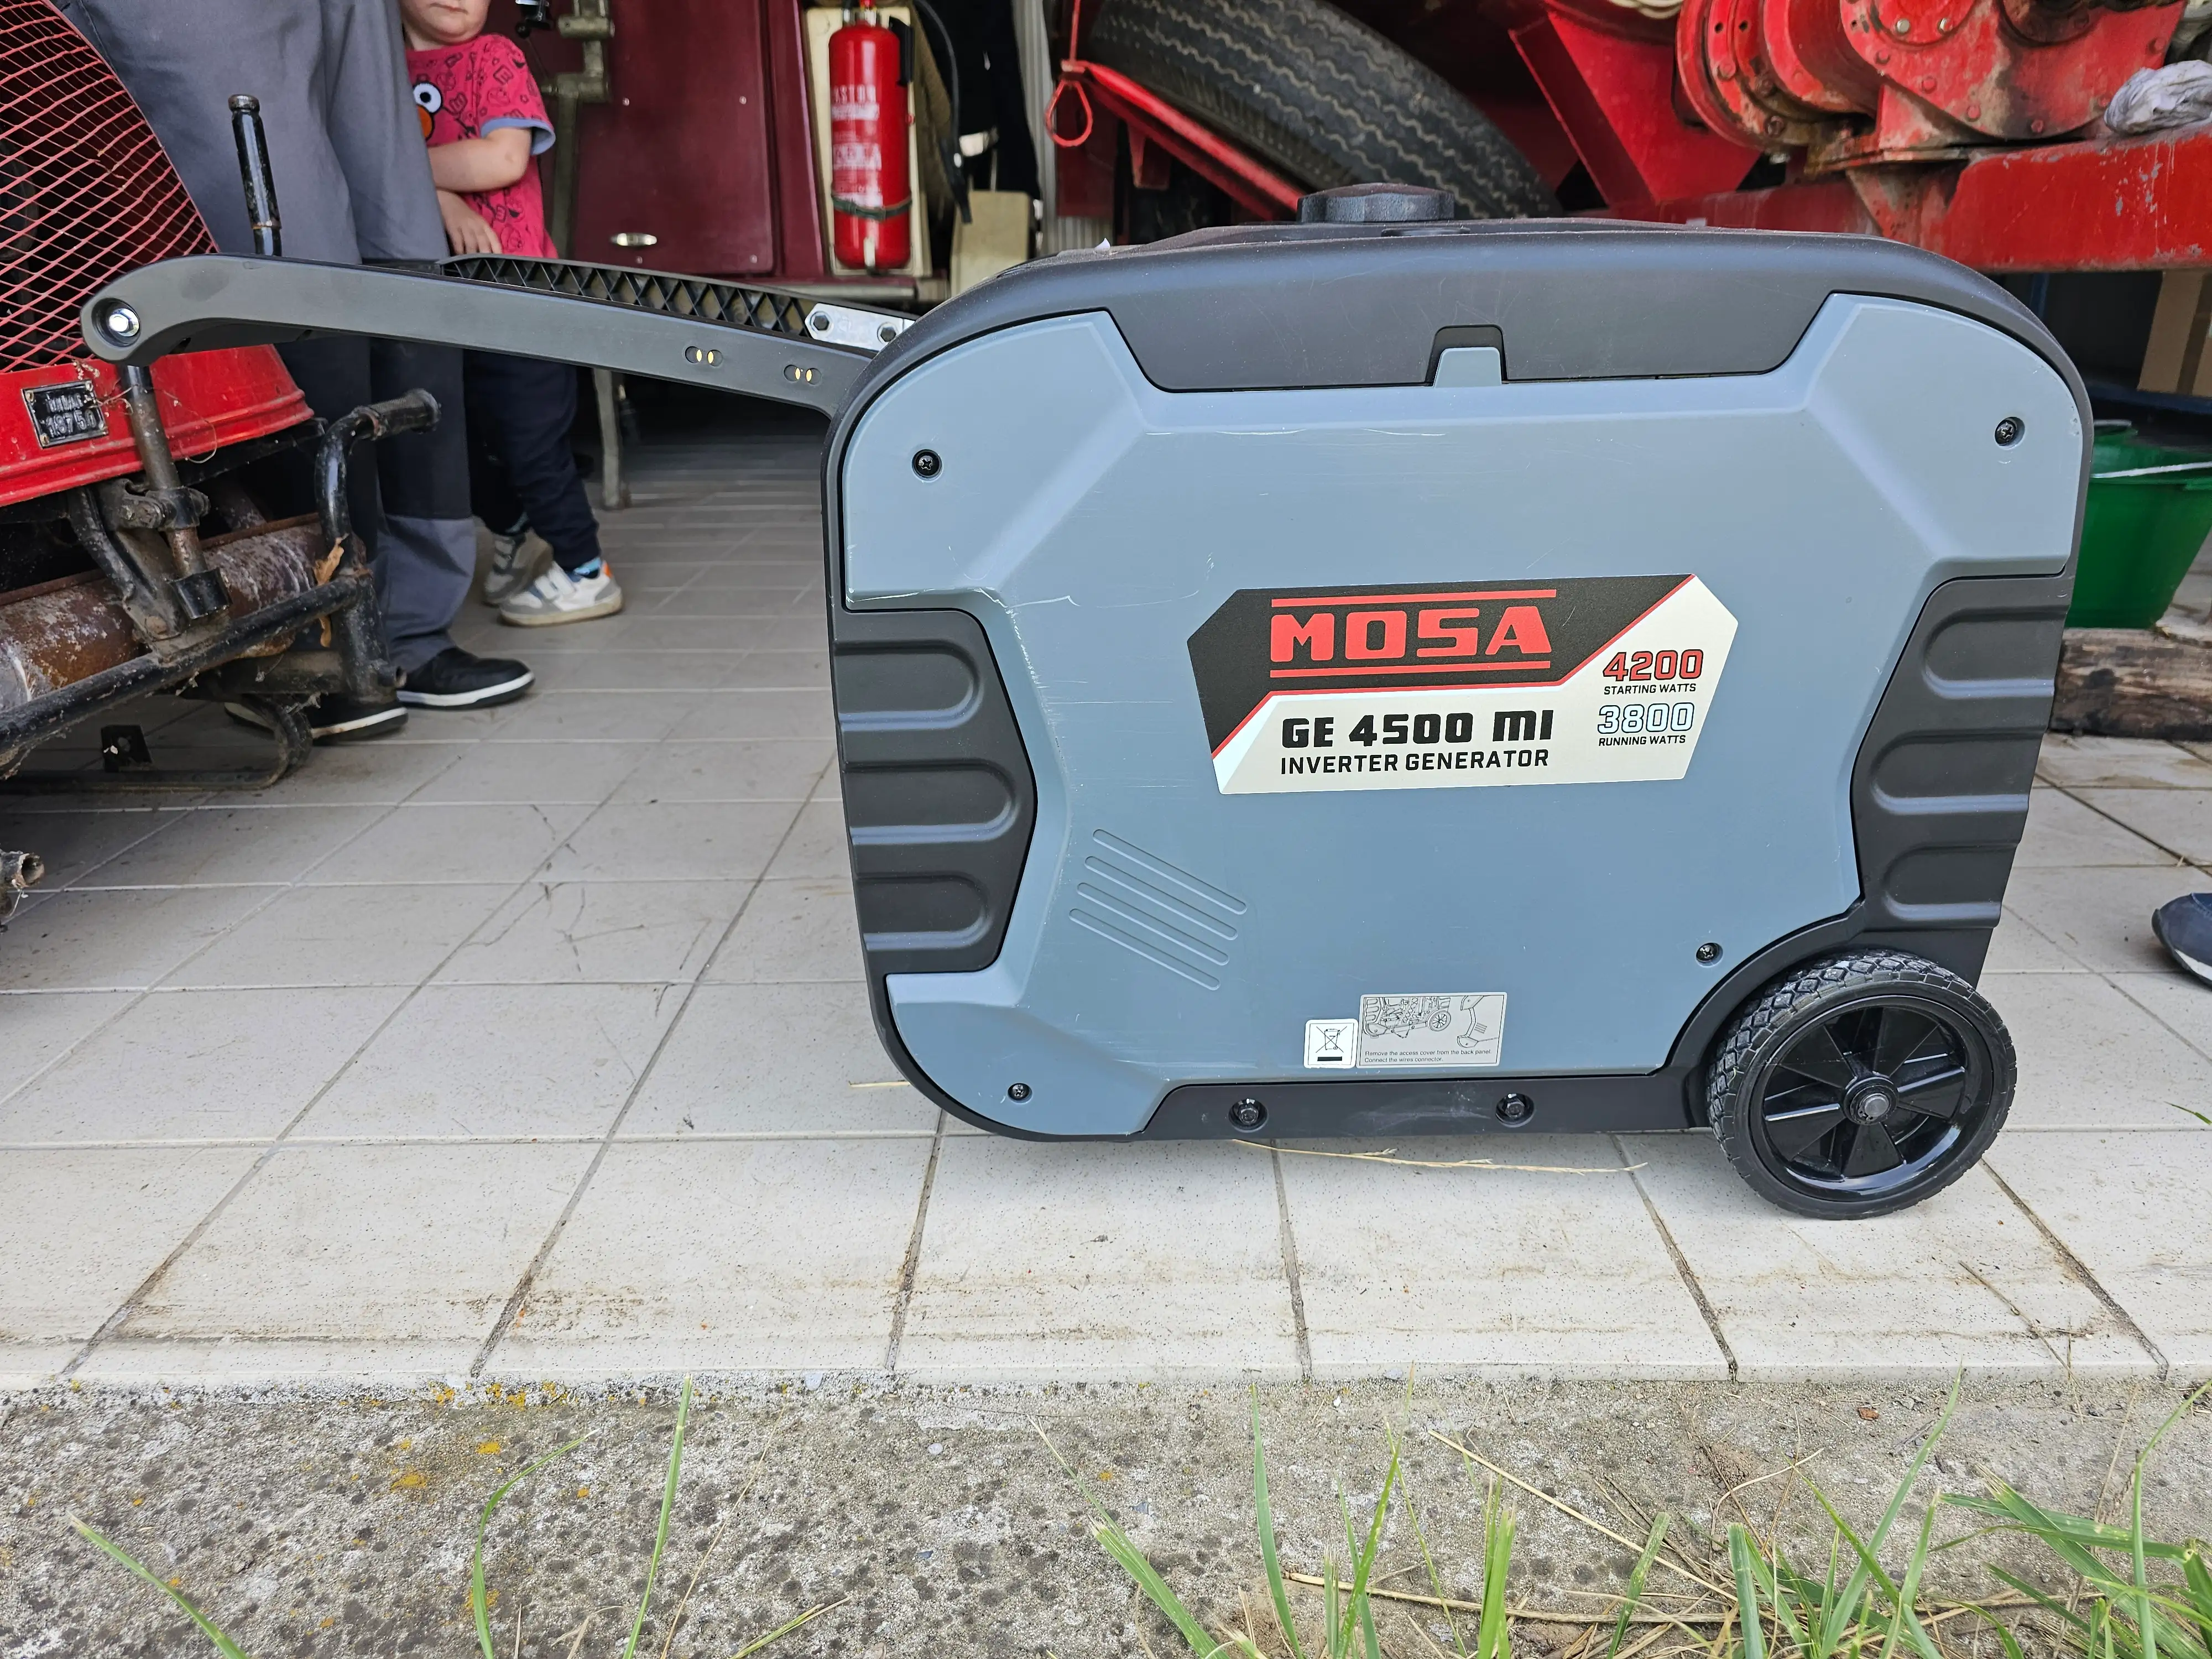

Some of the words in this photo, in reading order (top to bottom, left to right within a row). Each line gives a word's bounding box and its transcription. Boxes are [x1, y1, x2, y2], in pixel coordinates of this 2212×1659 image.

[1271, 607, 1552, 661] MOSA
[1603, 649, 1704, 682] 4200
[1604, 685, 1657, 695] STARTING
[1659, 683, 1697, 693] WATTS
[1282, 717, 1334, 749] GE
[1348, 712, 1473, 747] 4500
[1492, 709, 1554, 742] MI
[1597, 702, 1695, 734] 3800
[1598, 736, 1647, 747] RUNNING
[1649, 734, 1686, 745] WATTS
[1280, 754, 1399, 775] INVERTER
[1405, 749, 1549, 771] GENERATOR
